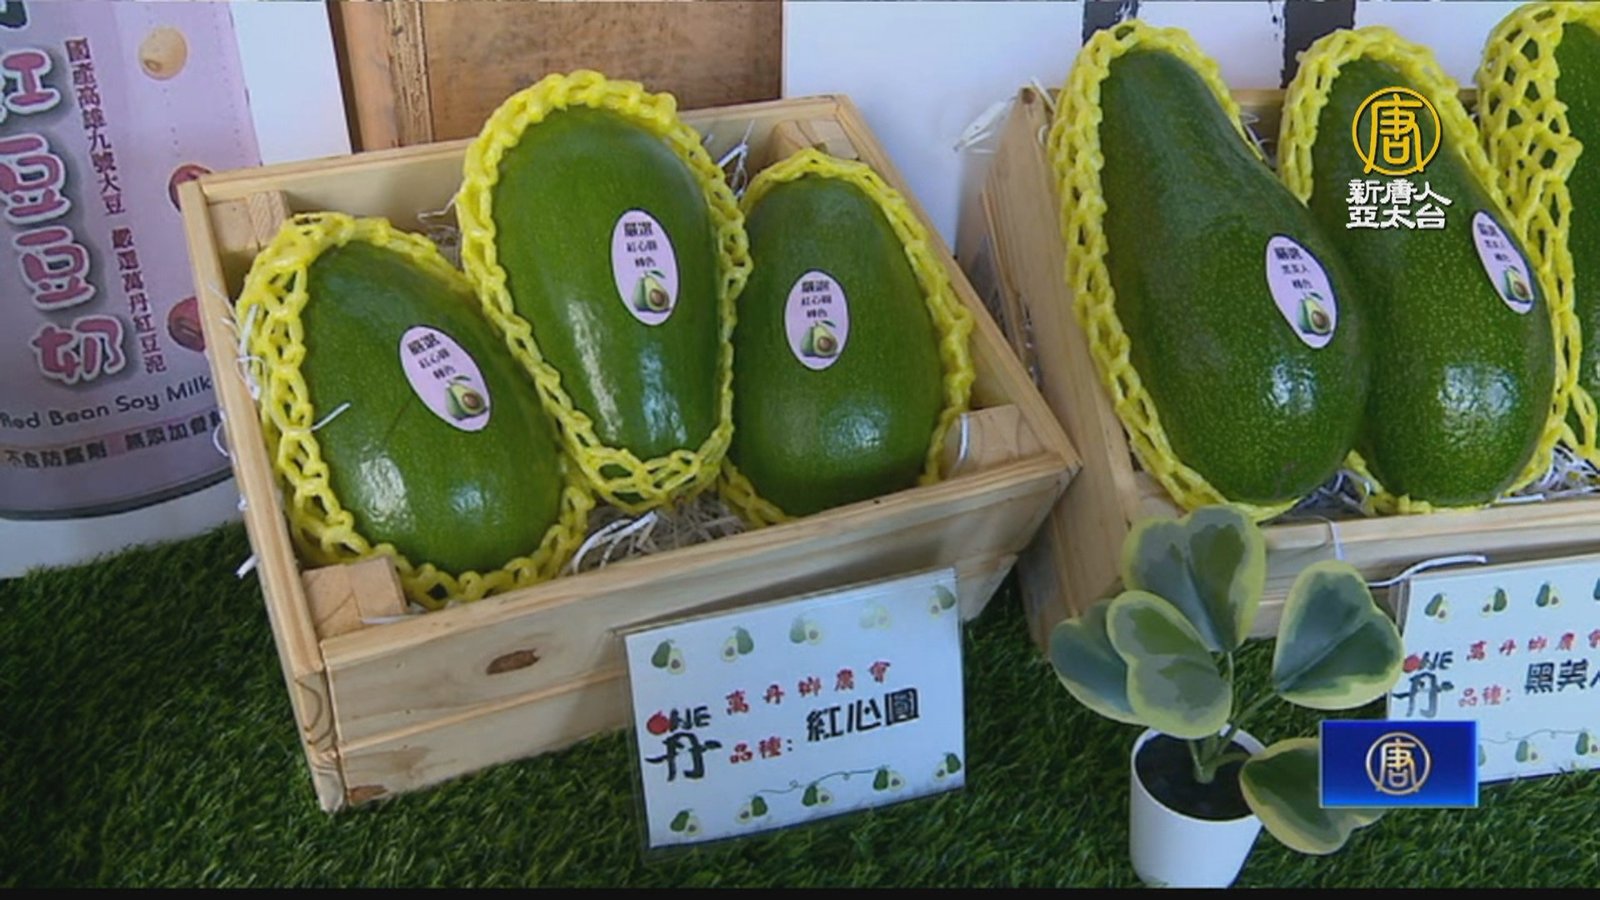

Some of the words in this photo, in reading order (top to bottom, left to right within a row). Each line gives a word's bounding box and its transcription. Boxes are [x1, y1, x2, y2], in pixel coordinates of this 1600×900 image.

[48, 404, 110, 426] Bean
[115, 394, 161, 412] Soy
[166, 375, 212, 402] Milk
[725, 660, 891, 716] 萬丹鄉農會
[806, 687, 920, 743] 紅心圓
